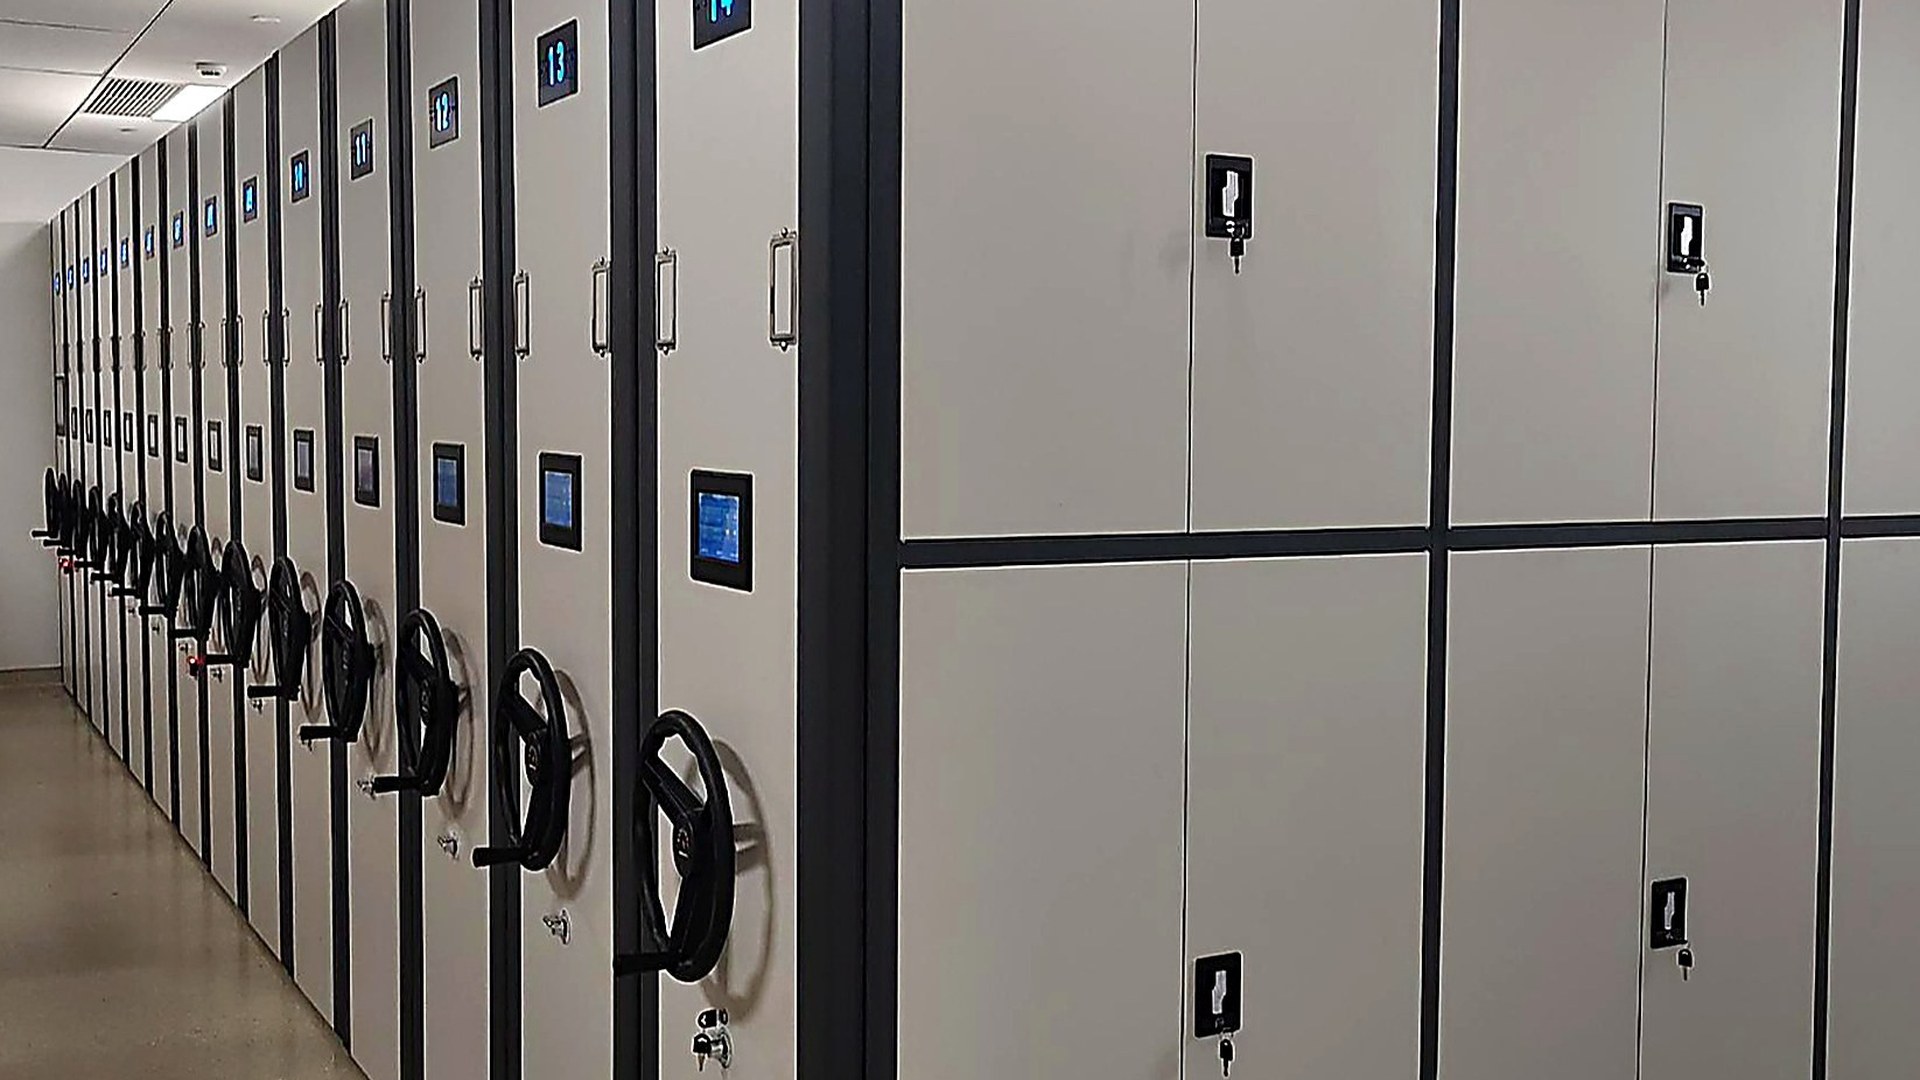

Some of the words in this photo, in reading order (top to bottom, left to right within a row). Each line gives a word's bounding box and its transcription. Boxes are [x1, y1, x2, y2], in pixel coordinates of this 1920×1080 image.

[548, 41, 564, 85] 13
[436, 93, 449, 131] 12
[355, 132, 366, 166] 11
